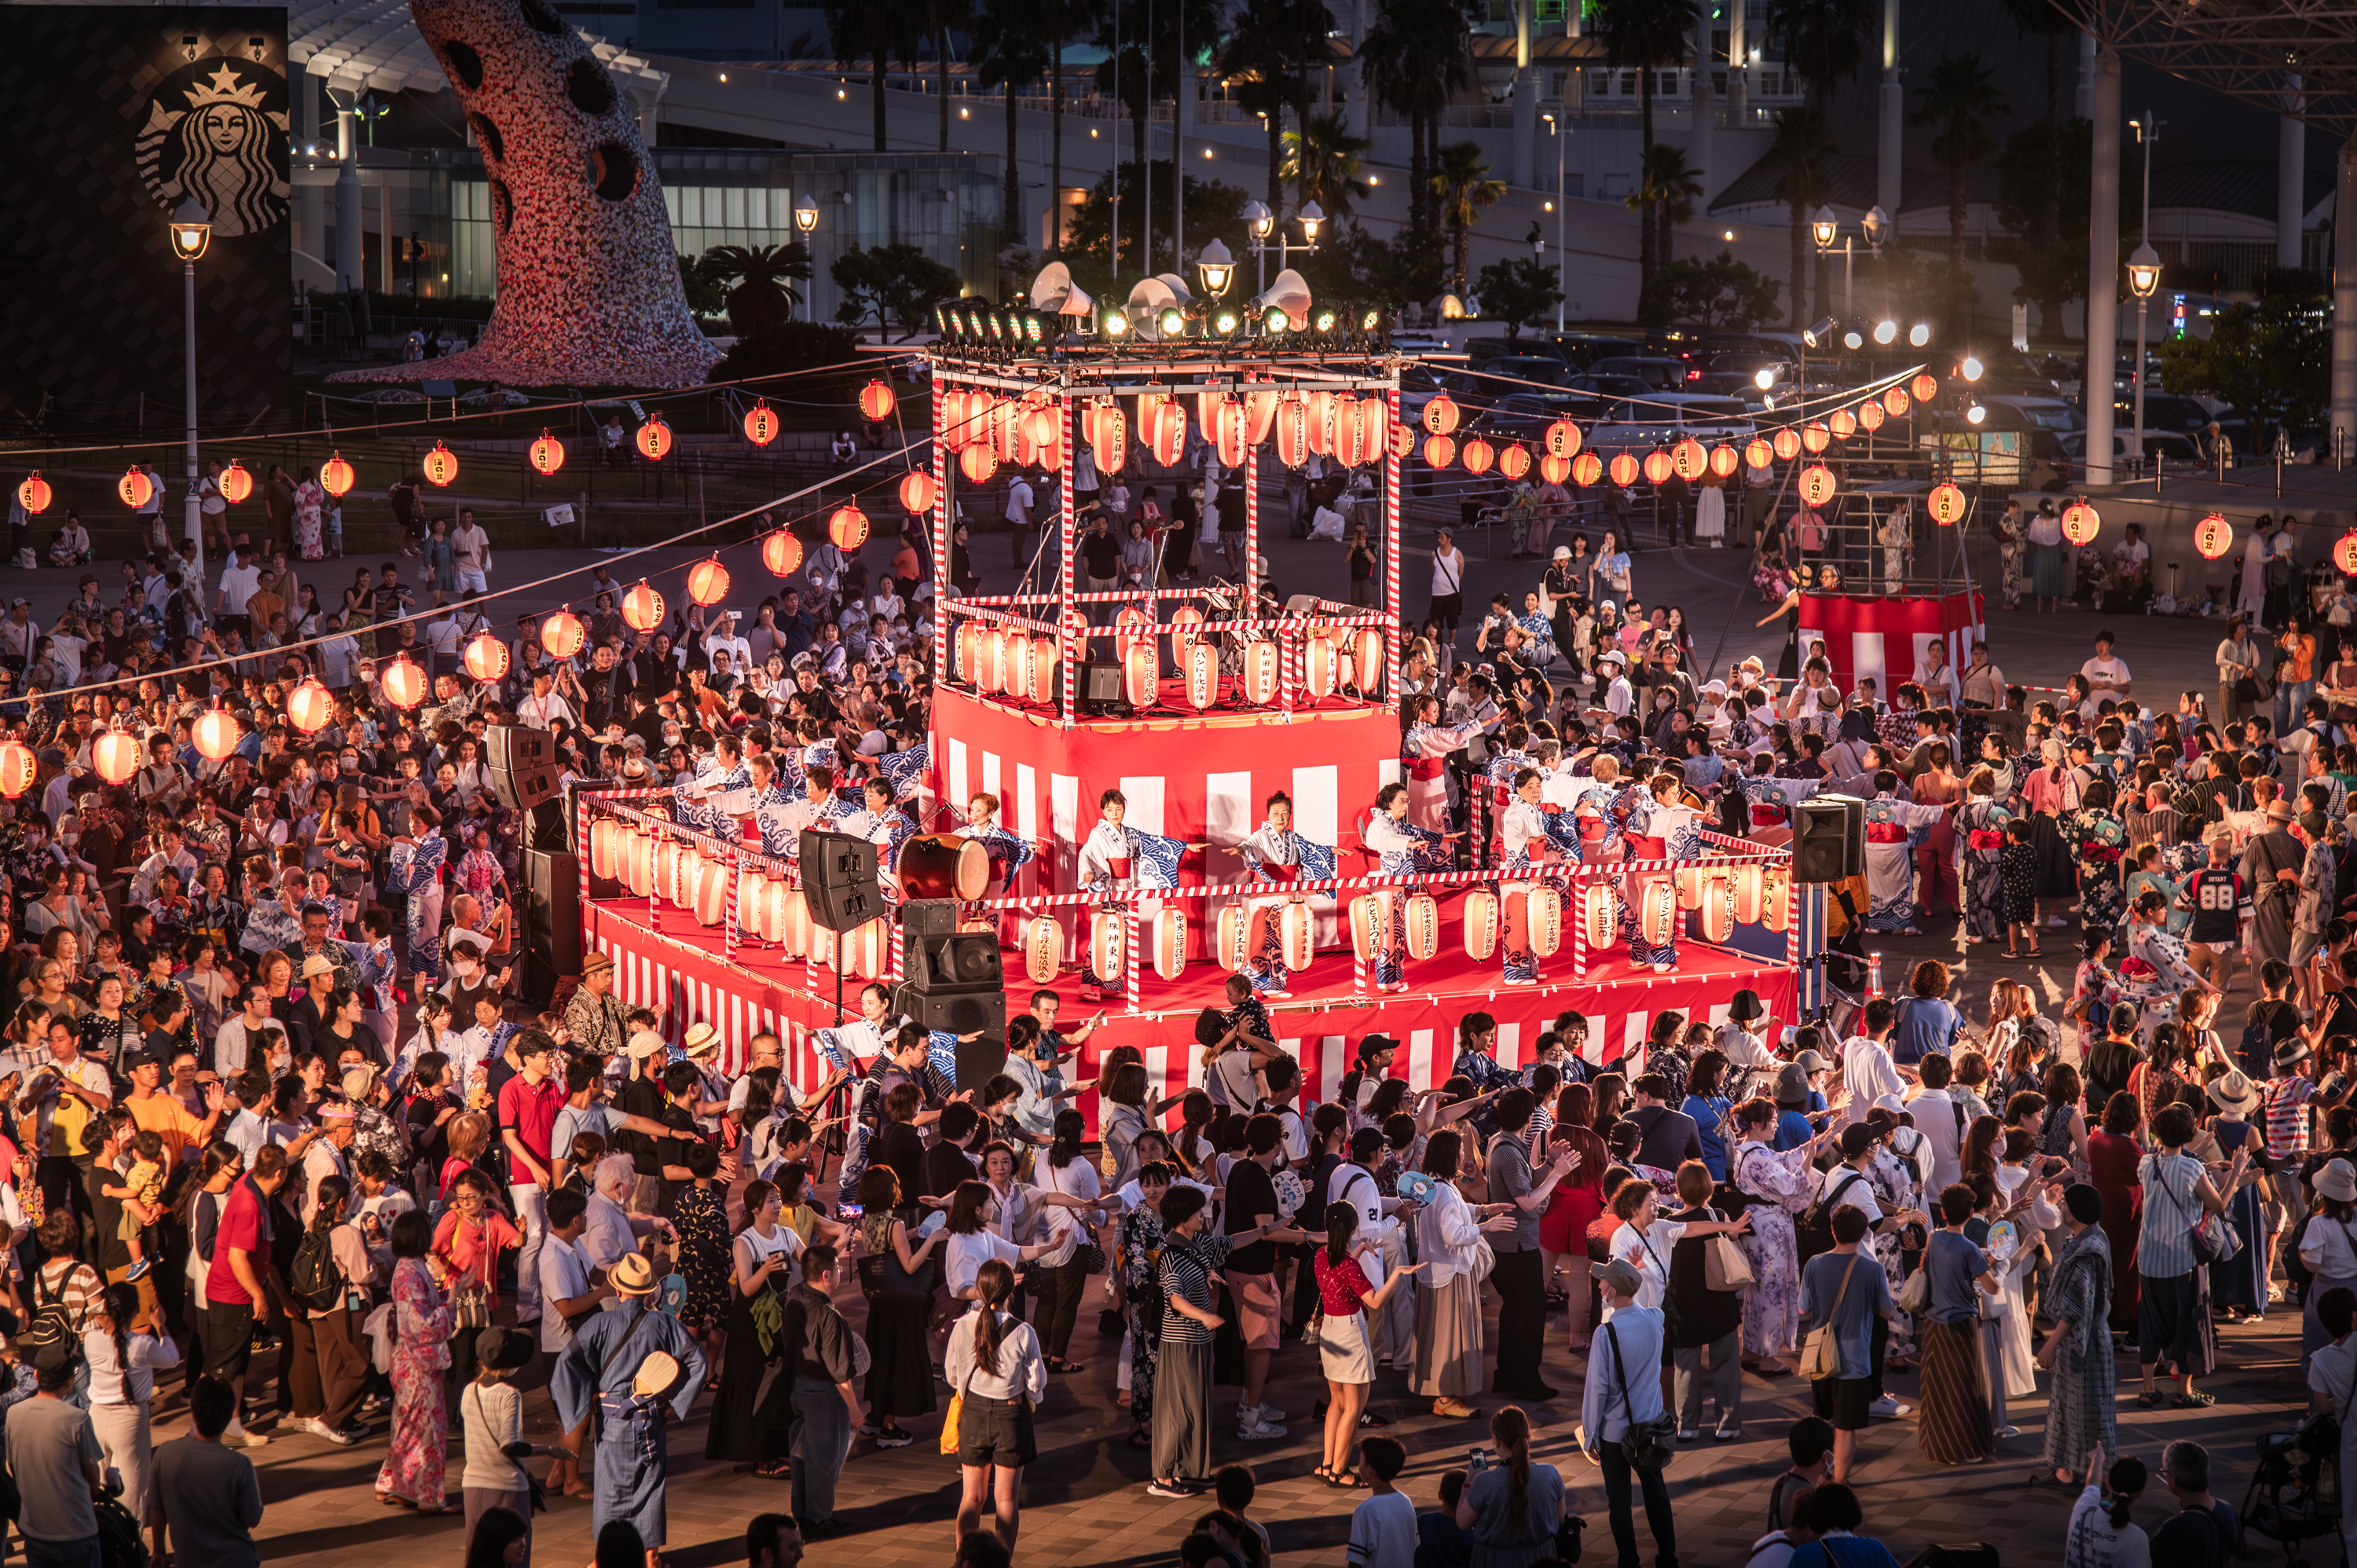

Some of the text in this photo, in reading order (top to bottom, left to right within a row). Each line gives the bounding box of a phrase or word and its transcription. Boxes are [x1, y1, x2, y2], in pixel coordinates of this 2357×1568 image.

[757, 415, 767, 438] 海の盆
[1430, 408, 1441, 430] 海の盆
[648, 430, 658, 453] 海の盆
[1113, 413, 1123, 461] みなと銀行
[1553, 428, 1564, 453] 海の盆
[434, 459, 444, 481] 海の盆
[537, 447, 547, 469] 海の盆
[1677, 449, 1689, 474] 海の盆
[123, 481, 135, 502] 海の盆
[1811, 475, 1820, 499] 海の盆
[1941, 495, 1950, 518] 海の盆
[2069, 514, 2080, 538] 海の盆
[2205, 524, 2216, 550] 海の盆
[1144, 649, 1155, 702] 生田遊技業組合
[1676, 871, 1685, 896] の盆
[1723, 882, 1734, 937] 六甲ビール醸造所
[1763, 877, 1774, 922] 海の盆
[2200, 885, 2234, 910] 88
[1365, 897, 1380, 954] 神戸どうぶつ王国
[1421, 897, 1433, 956] 神戸市中央区薬剤師会
[1483, 897, 1494, 956] 神戸市中央区医師会
[1598, 907, 1607, 937] umie
[1037, 922, 1051, 979] 中央区社会福祉協議会
[1174, 914, 1184, 973] 中央区保護司会
